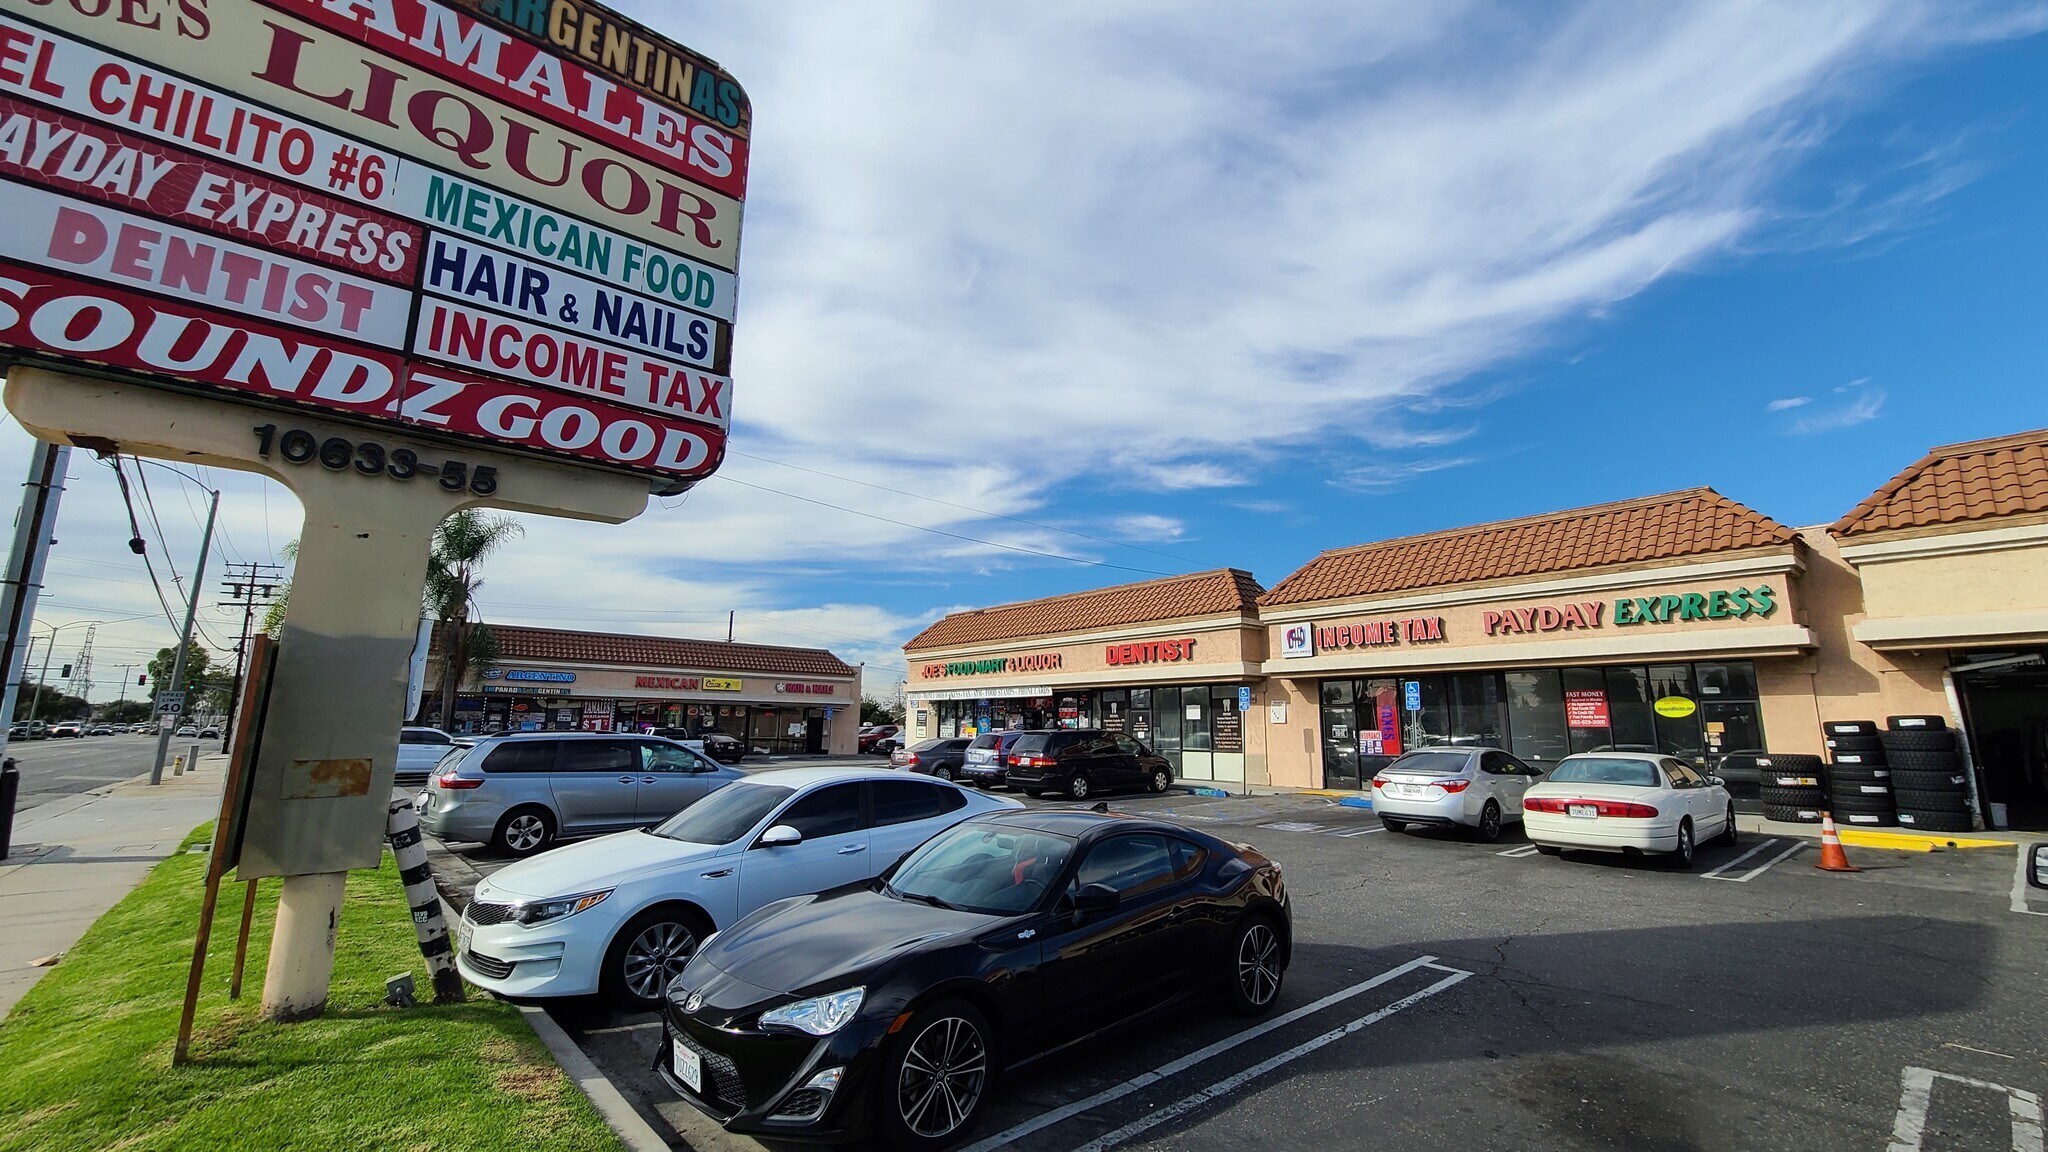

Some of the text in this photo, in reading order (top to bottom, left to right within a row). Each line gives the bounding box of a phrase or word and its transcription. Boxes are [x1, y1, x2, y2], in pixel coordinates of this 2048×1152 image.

[0, 24, 385, 200] EL CHILITO #6
[305, 0, 733, 177] AMALES
[252, 20, 722, 249] LIQUOR
[0, 112, 412, 271] AYDAY EXPRESS
[47, 206, 374, 333] DENTIST
[425, 175, 715, 308] MEXICAN FOOD
[430, 241, 708, 360] HAIR & NAILS
[428, 307, 723, 419] INCOME TAX
[253, 423, 497, 496] 10633-55
[476, 395, 708, 469] GOOD
[1315, 616, 1442, 648] INCOME TAX
[1483, 584, 1773, 634] PAYDAY EXPRE$$
[506, 670, 575, 682] ARGENTINO
[921, 663, 947, 678] JOE'S
[947, 661, 976, 676] FOOD
[976, 657, 1007, 674] MART
[1017, 652, 1061, 672] LIQUOR
[1105, 638, 1195, 665] DENTIST
[159, 703, 181, 712] 40
[584, 701, 611, 713] TAMALES
[635, 676, 699, 689] MEXICAN
[786, 683, 804, 693] HAIR
[813, 684, 834, 694] NAILS
[1382, 706, 1395, 740] TAXES
